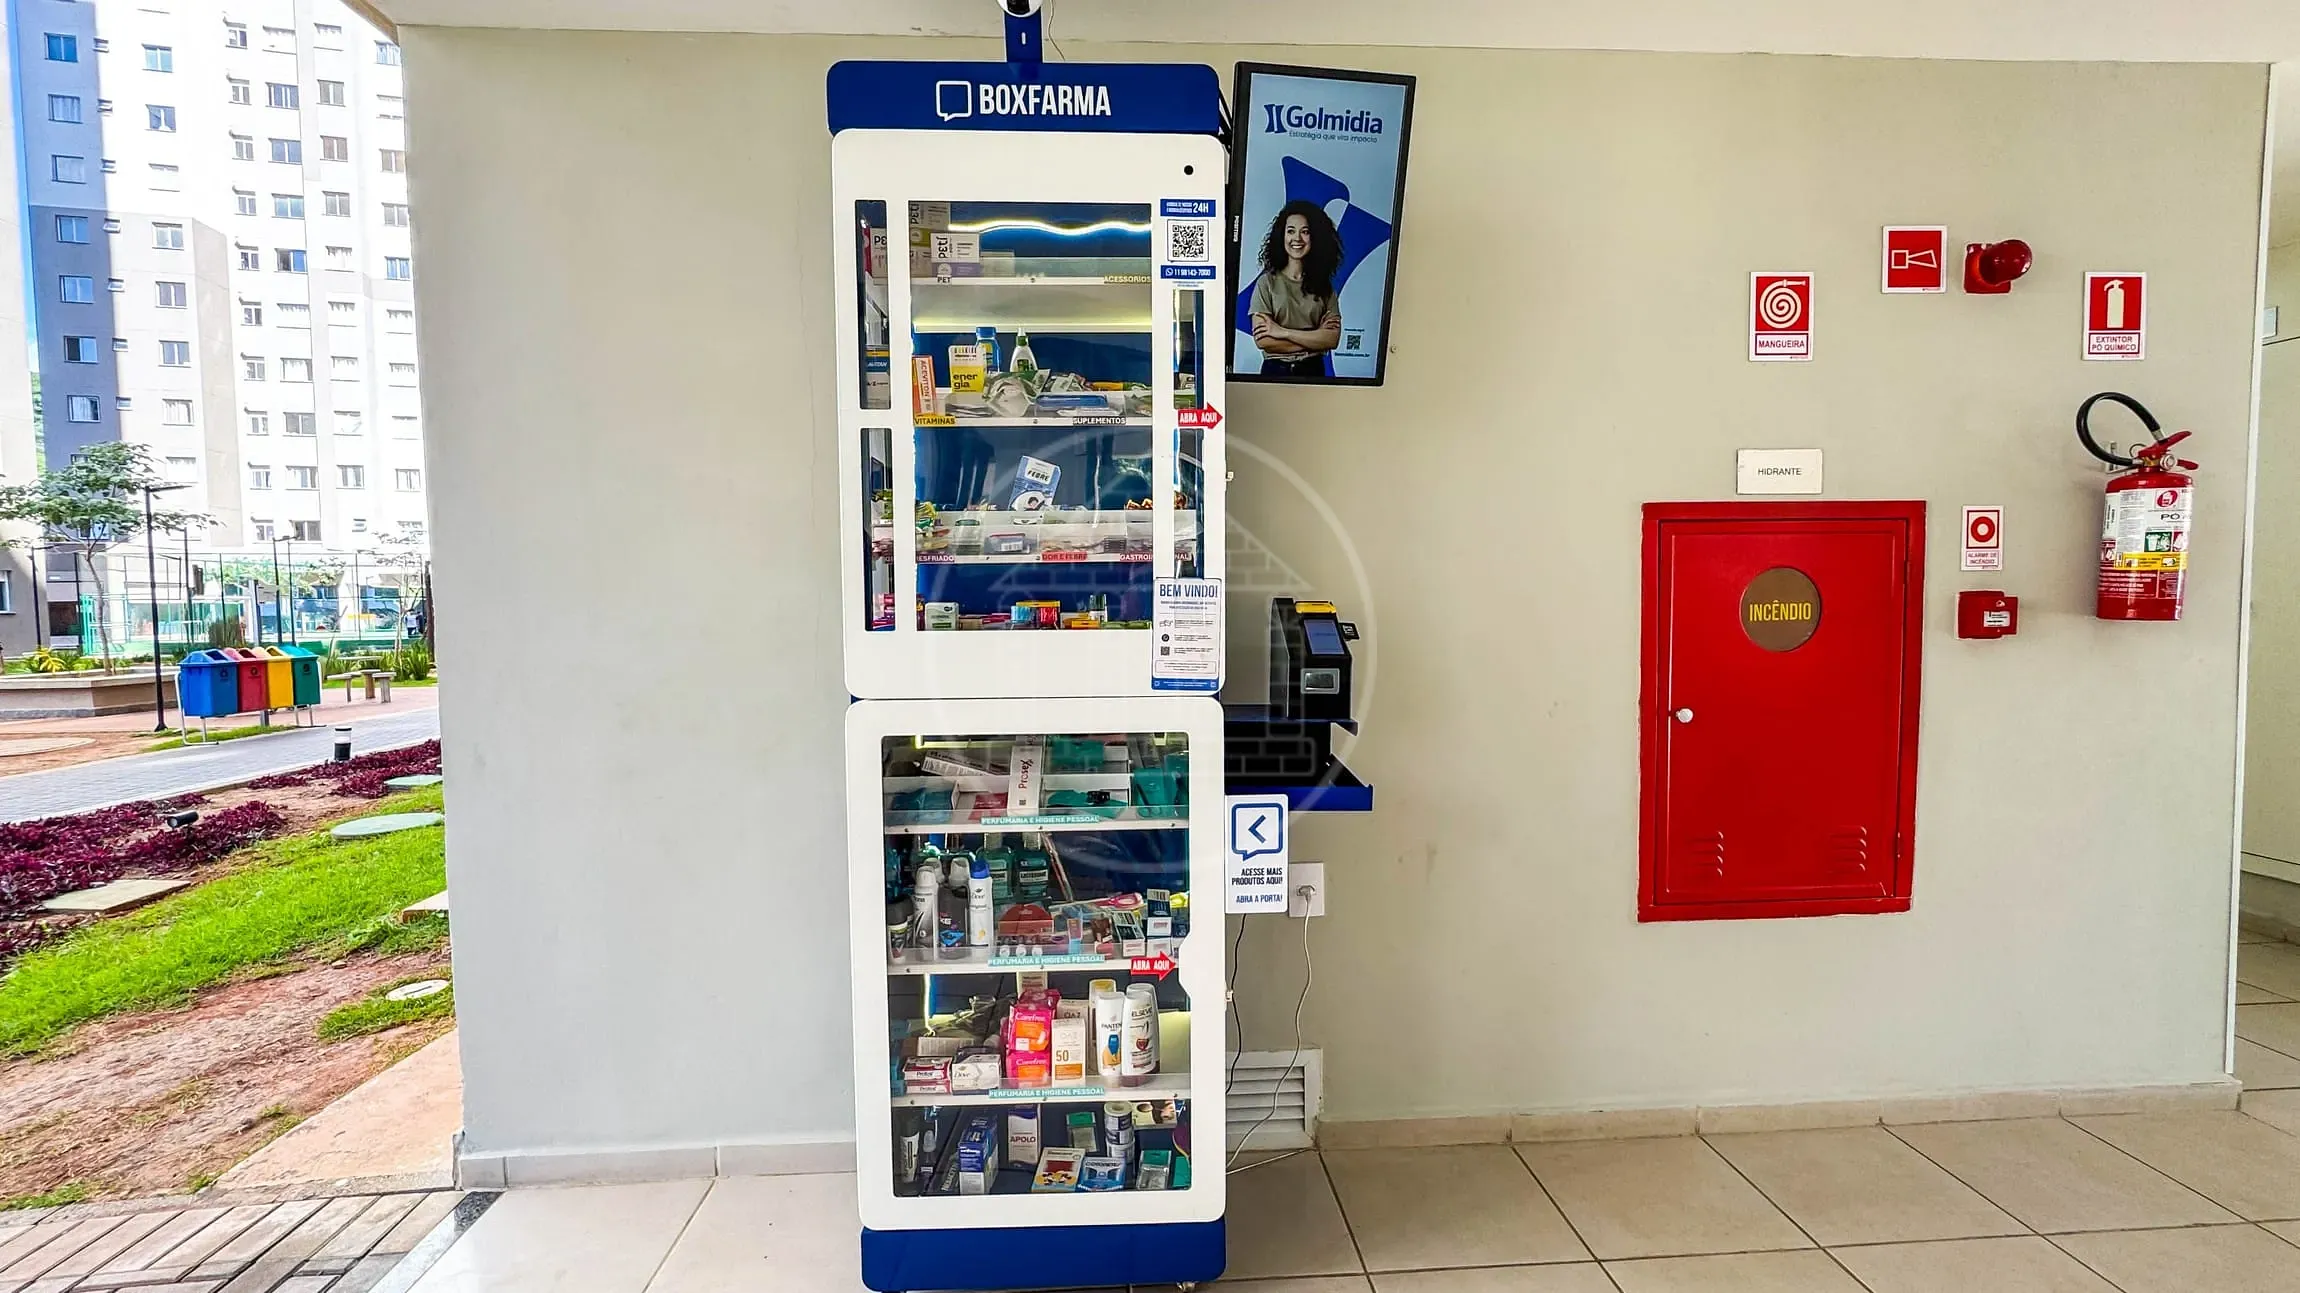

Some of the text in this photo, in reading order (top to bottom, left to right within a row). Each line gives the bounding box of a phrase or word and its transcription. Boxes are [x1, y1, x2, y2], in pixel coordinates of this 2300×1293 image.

[979, 83, 1112, 116] BOXFARMA
[1286, 105, 1383, 134] Golmidia
[1351, 135, 1378, 143] impacto
[1193, 203, 1209, 213] 24H
[1758, 340, 1805, 348] MANGUEIRA
[953, 373, 978, 381] ener
[953, 380, 971, 390] gia
[1073, 417, 1126, 425] SUPLEMENTOS
[1179, 412, 1218, 423] ABRA AQUI
[1757, 467, 1802, 476] HIDRANTE
[1160, 584, 1218, 598] BEM VINDO!
[1749, 599, 1812, 622] INCÊNDIO
[1240, 867, 1283, 877] ACESSE MAIS
[1231, 876, 1283, 886] PRODUTOS AQUI!
[1236, 895, 1253, 903] ABRA
[1260, 894, 1283, 902] PORTA!
[1133, 959, 1170, 970] ABRA AQUI
[1055, 1049, 1070, 1062] 50
[989, 1089, 1035, 1097] PERFUMARIA
